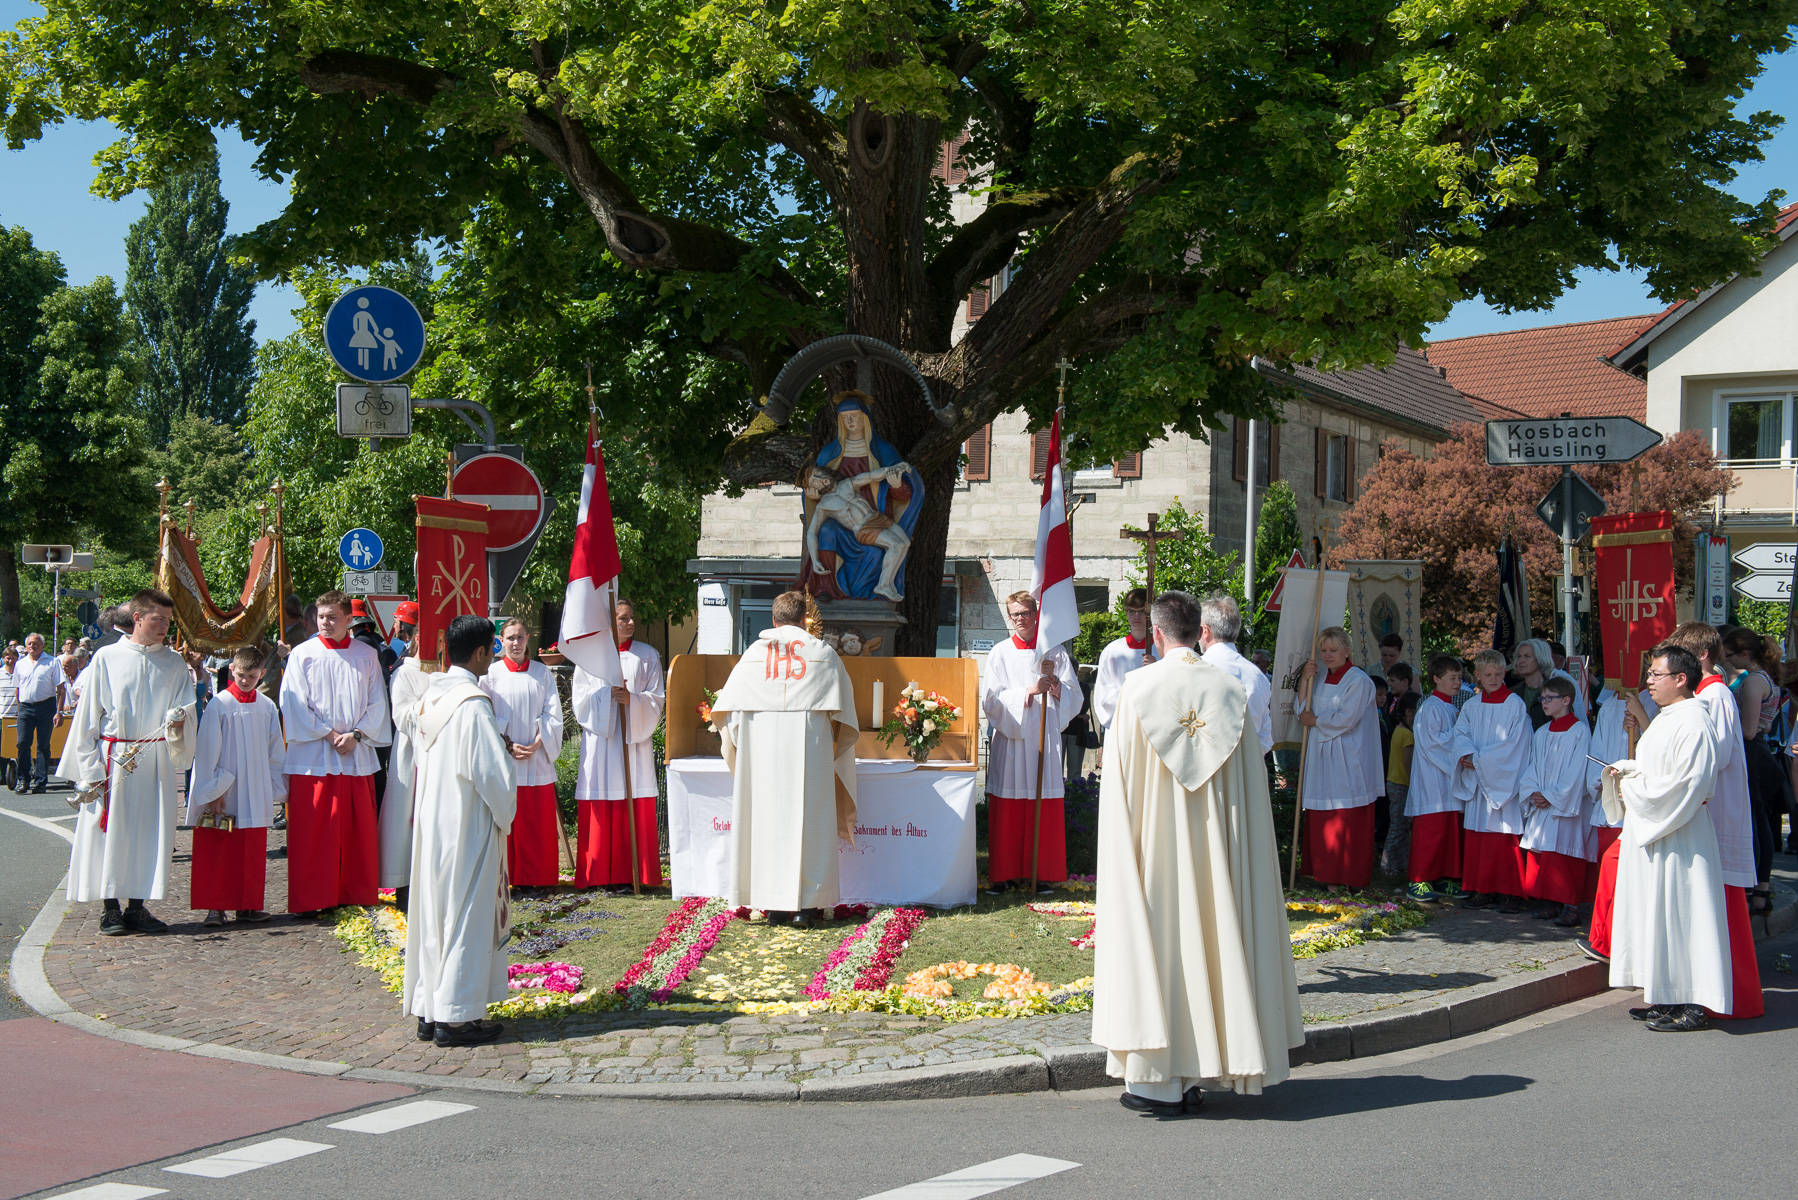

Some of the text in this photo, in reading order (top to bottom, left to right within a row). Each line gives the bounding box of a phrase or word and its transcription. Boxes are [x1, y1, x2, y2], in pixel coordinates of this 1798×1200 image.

[365, 419, 386, 429] frei
[1508, 423, 1606, 440] Kosbach
[1508, 441, 1606, 459] Häusling
[1774, 551, 1796, 563] Ste
[180, 565, 198, 593] DATUS
[1777, 581, 1792, 592] Ze
[765, 639, 807, 681] IHS
[891, 825, 902, 837] des
[906, 821, 928, 838] Altars
